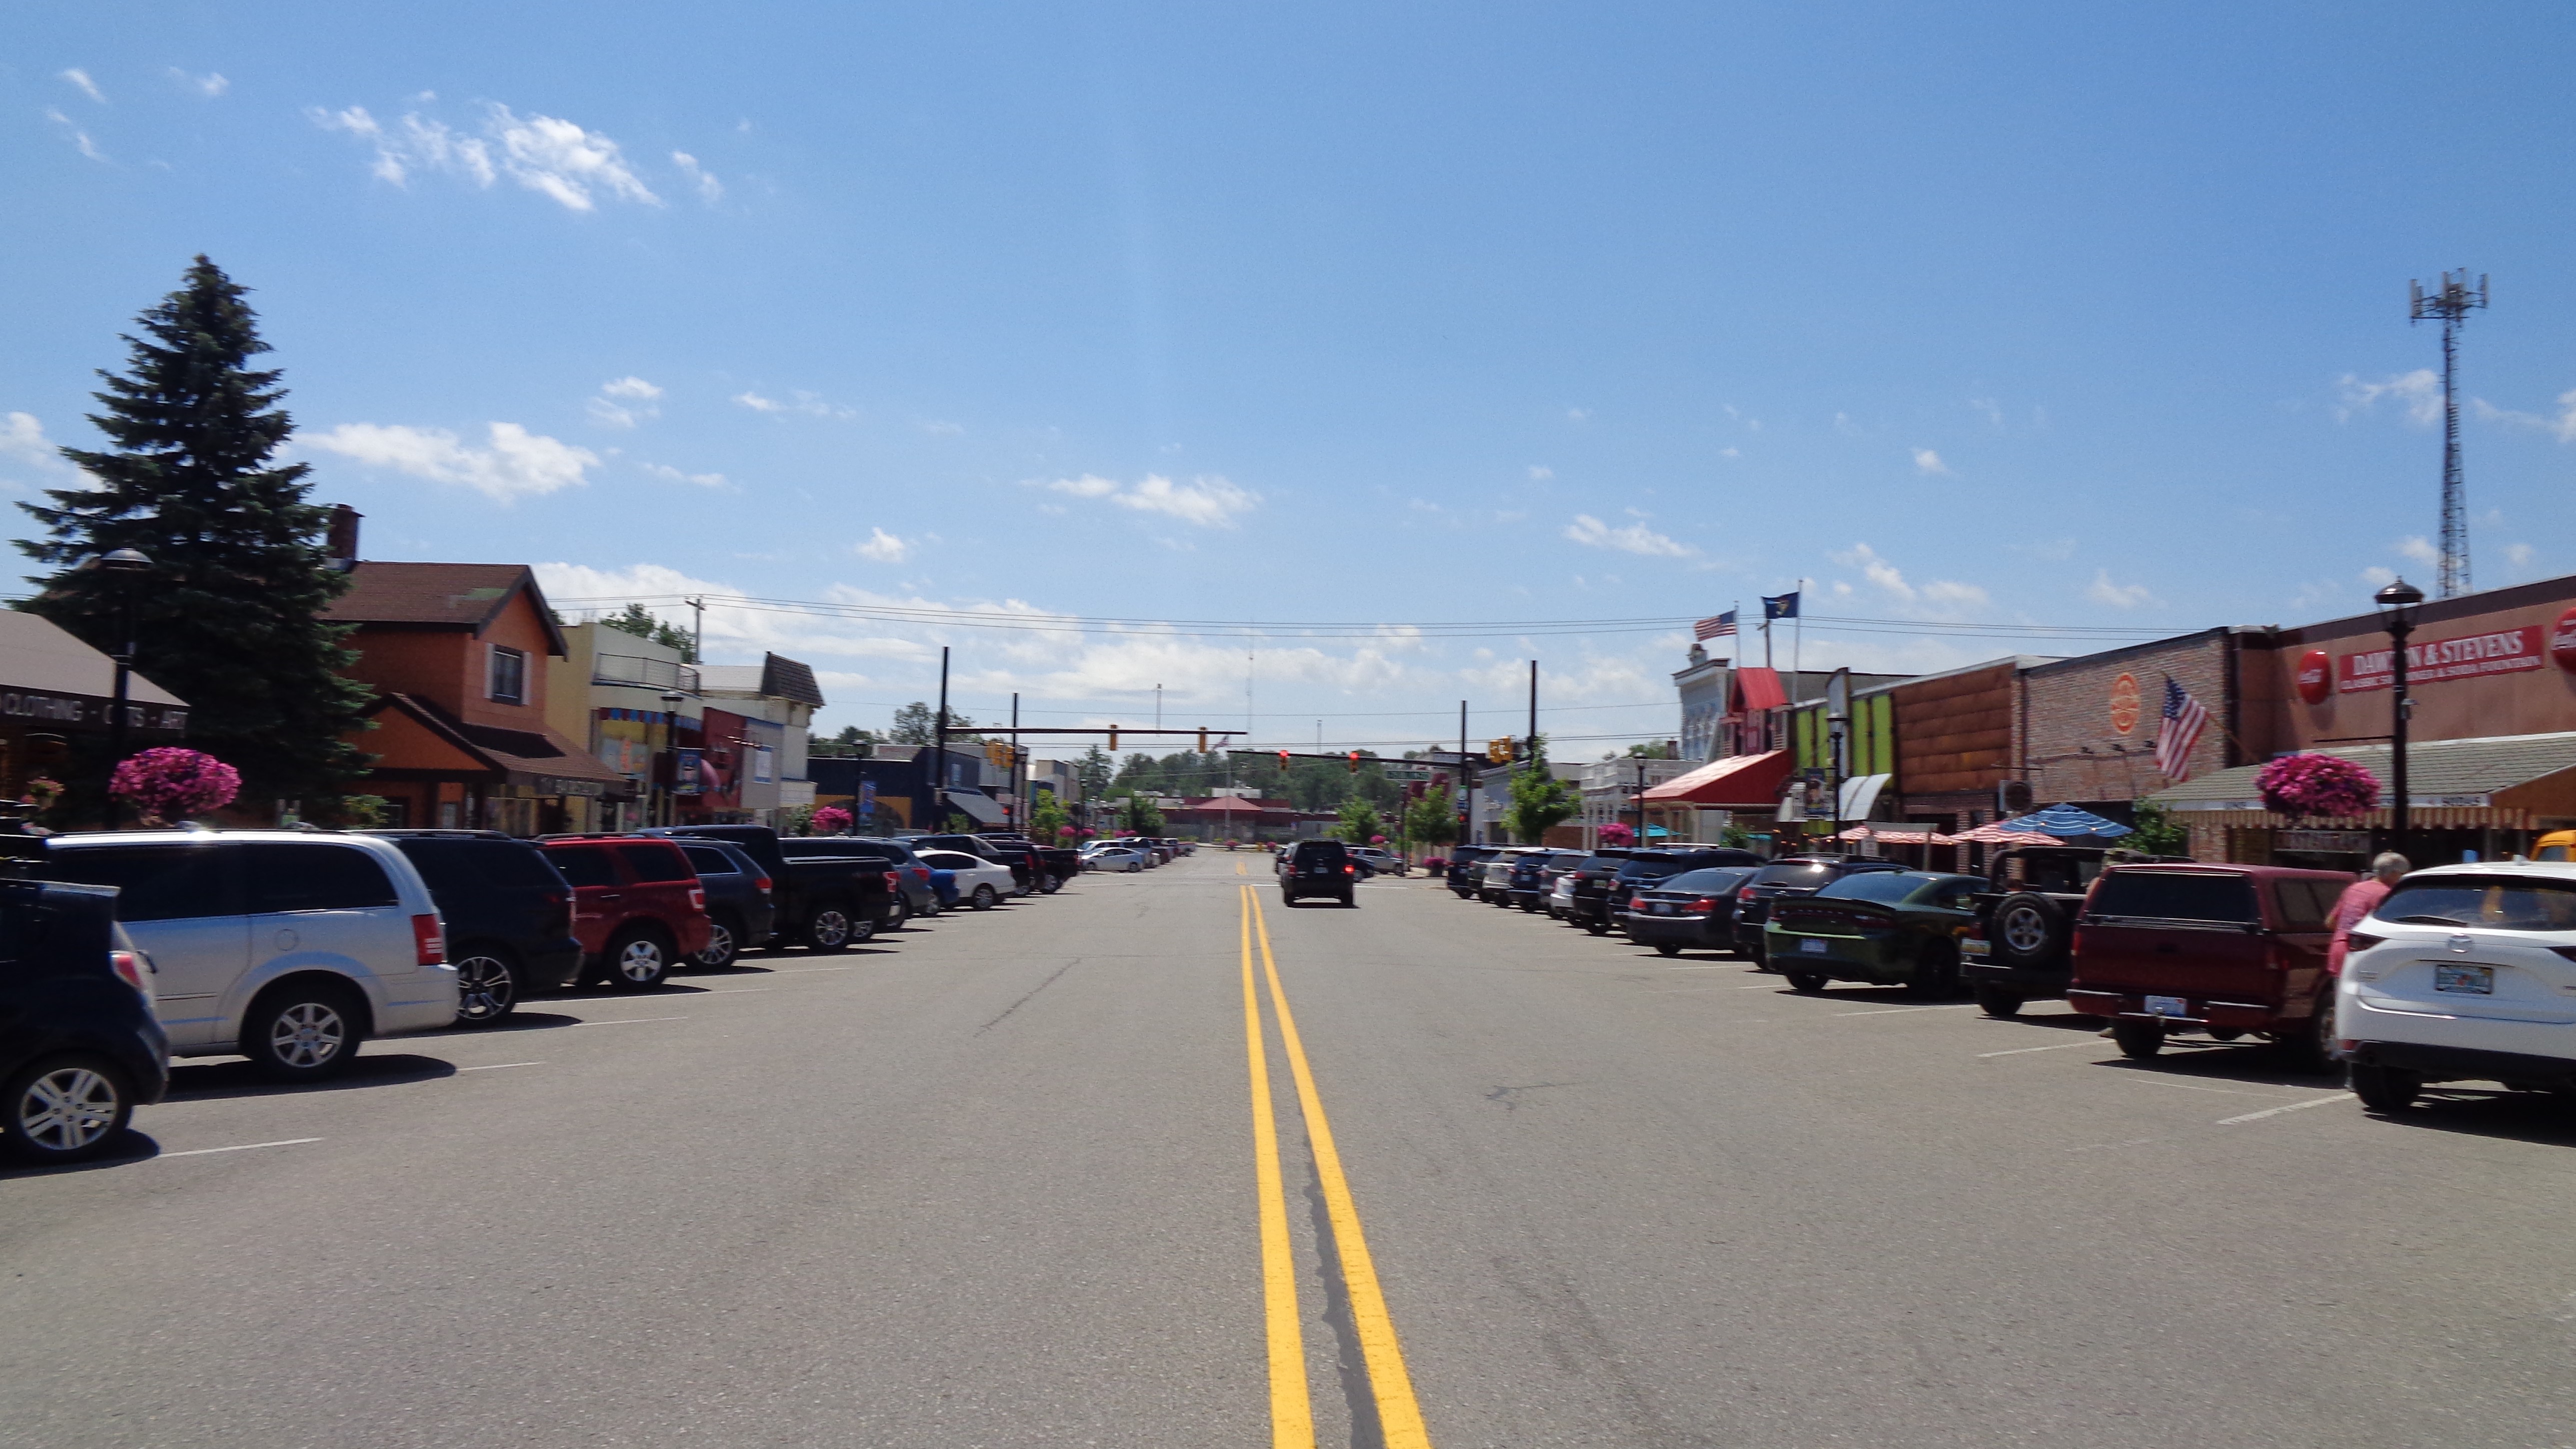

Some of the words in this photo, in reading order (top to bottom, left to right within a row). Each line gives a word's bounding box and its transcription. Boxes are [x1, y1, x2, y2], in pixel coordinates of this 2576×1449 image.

[2424, 644, 2438, 666] &
[2441, 630, 2523, 664] STEVENS
[4, 692, 84, 722] CLOTHING
